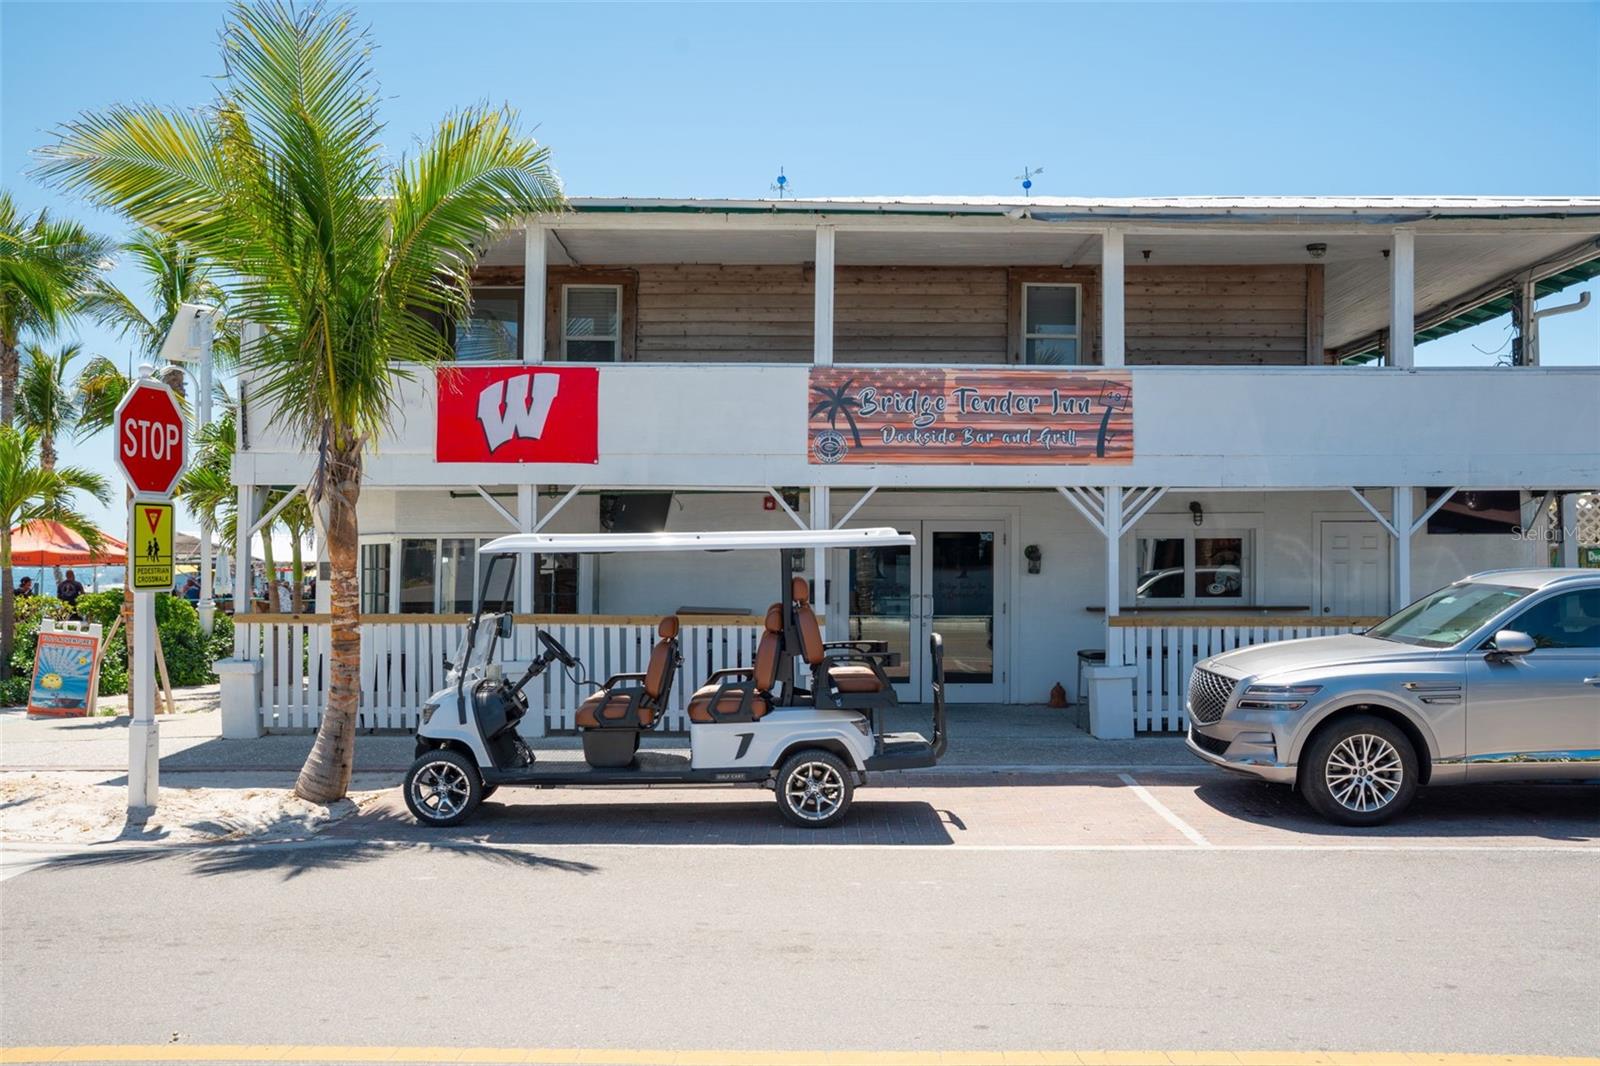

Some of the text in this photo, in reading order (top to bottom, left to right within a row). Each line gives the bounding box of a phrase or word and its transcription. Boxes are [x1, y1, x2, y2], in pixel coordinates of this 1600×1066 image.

[476, 372, 561, 455] W
[857, 386, 1092, 428] Bridge Tender Inn
[124, 418, 180, 461] STOP
[880, 425, 1077, 450] Dockside Bar and Grill
[137, 567, 170, 575] PEDESTRIAN
[137, 575, 169, 583] CROSSWALK
